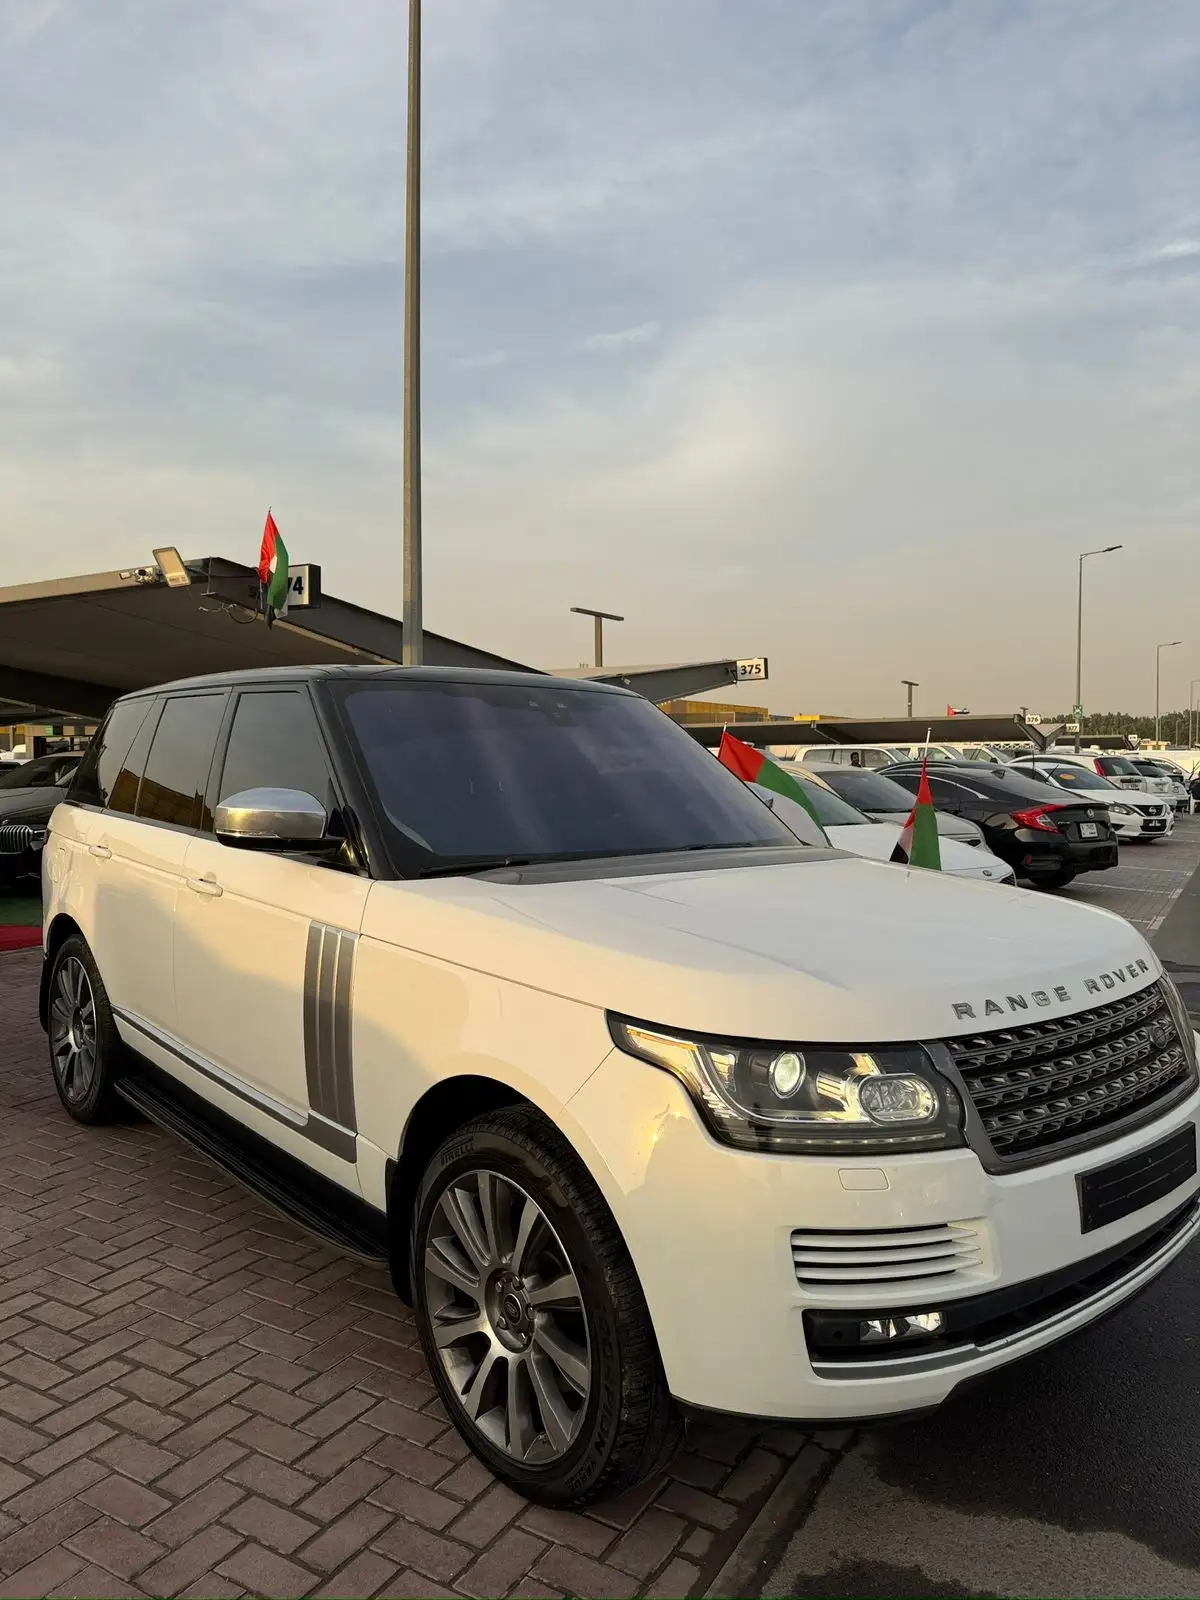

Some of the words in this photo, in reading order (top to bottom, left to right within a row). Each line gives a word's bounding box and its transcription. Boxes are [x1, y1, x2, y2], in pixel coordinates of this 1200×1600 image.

[740, 664, 762, 675] 375
[952, 985, 1072, 1020] RANGE
[1083, 958, 1149, 994] ROVER
